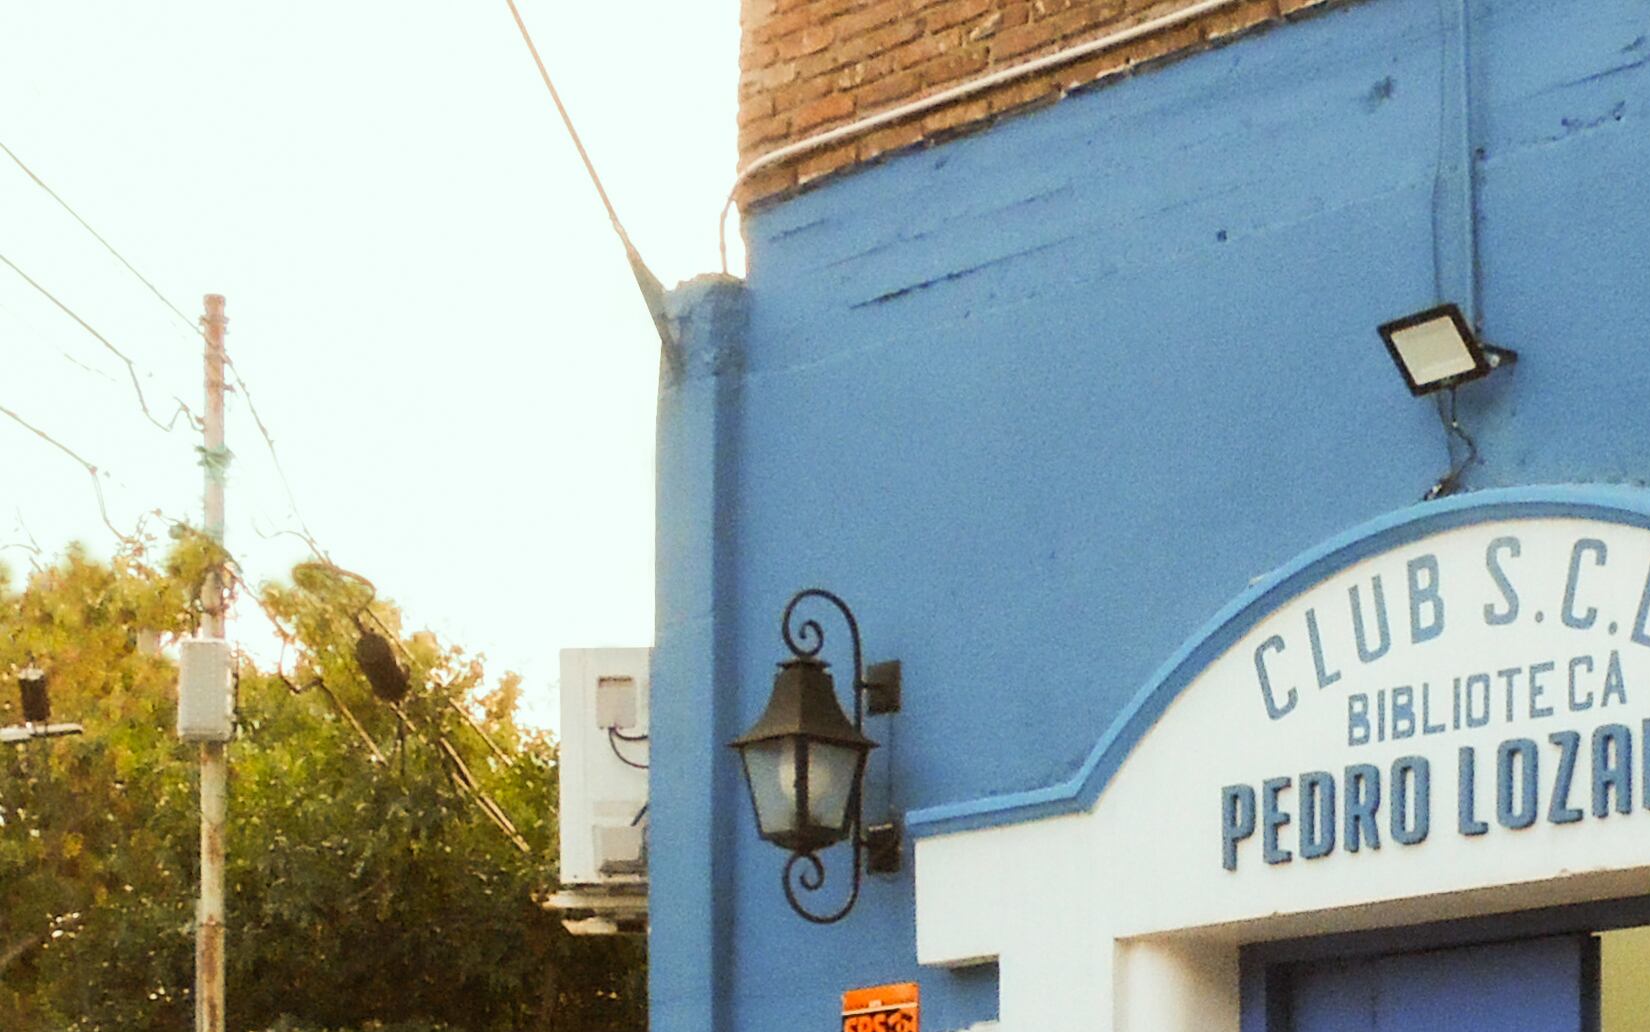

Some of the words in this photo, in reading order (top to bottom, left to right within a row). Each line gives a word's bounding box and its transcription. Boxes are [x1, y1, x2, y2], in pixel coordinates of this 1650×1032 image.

[1253, 553, 1446, 721] CLUB
[1347, 650, 1628, 747] BIBLIOTECA
[1221, 755, 1431, 872] PEDRO
